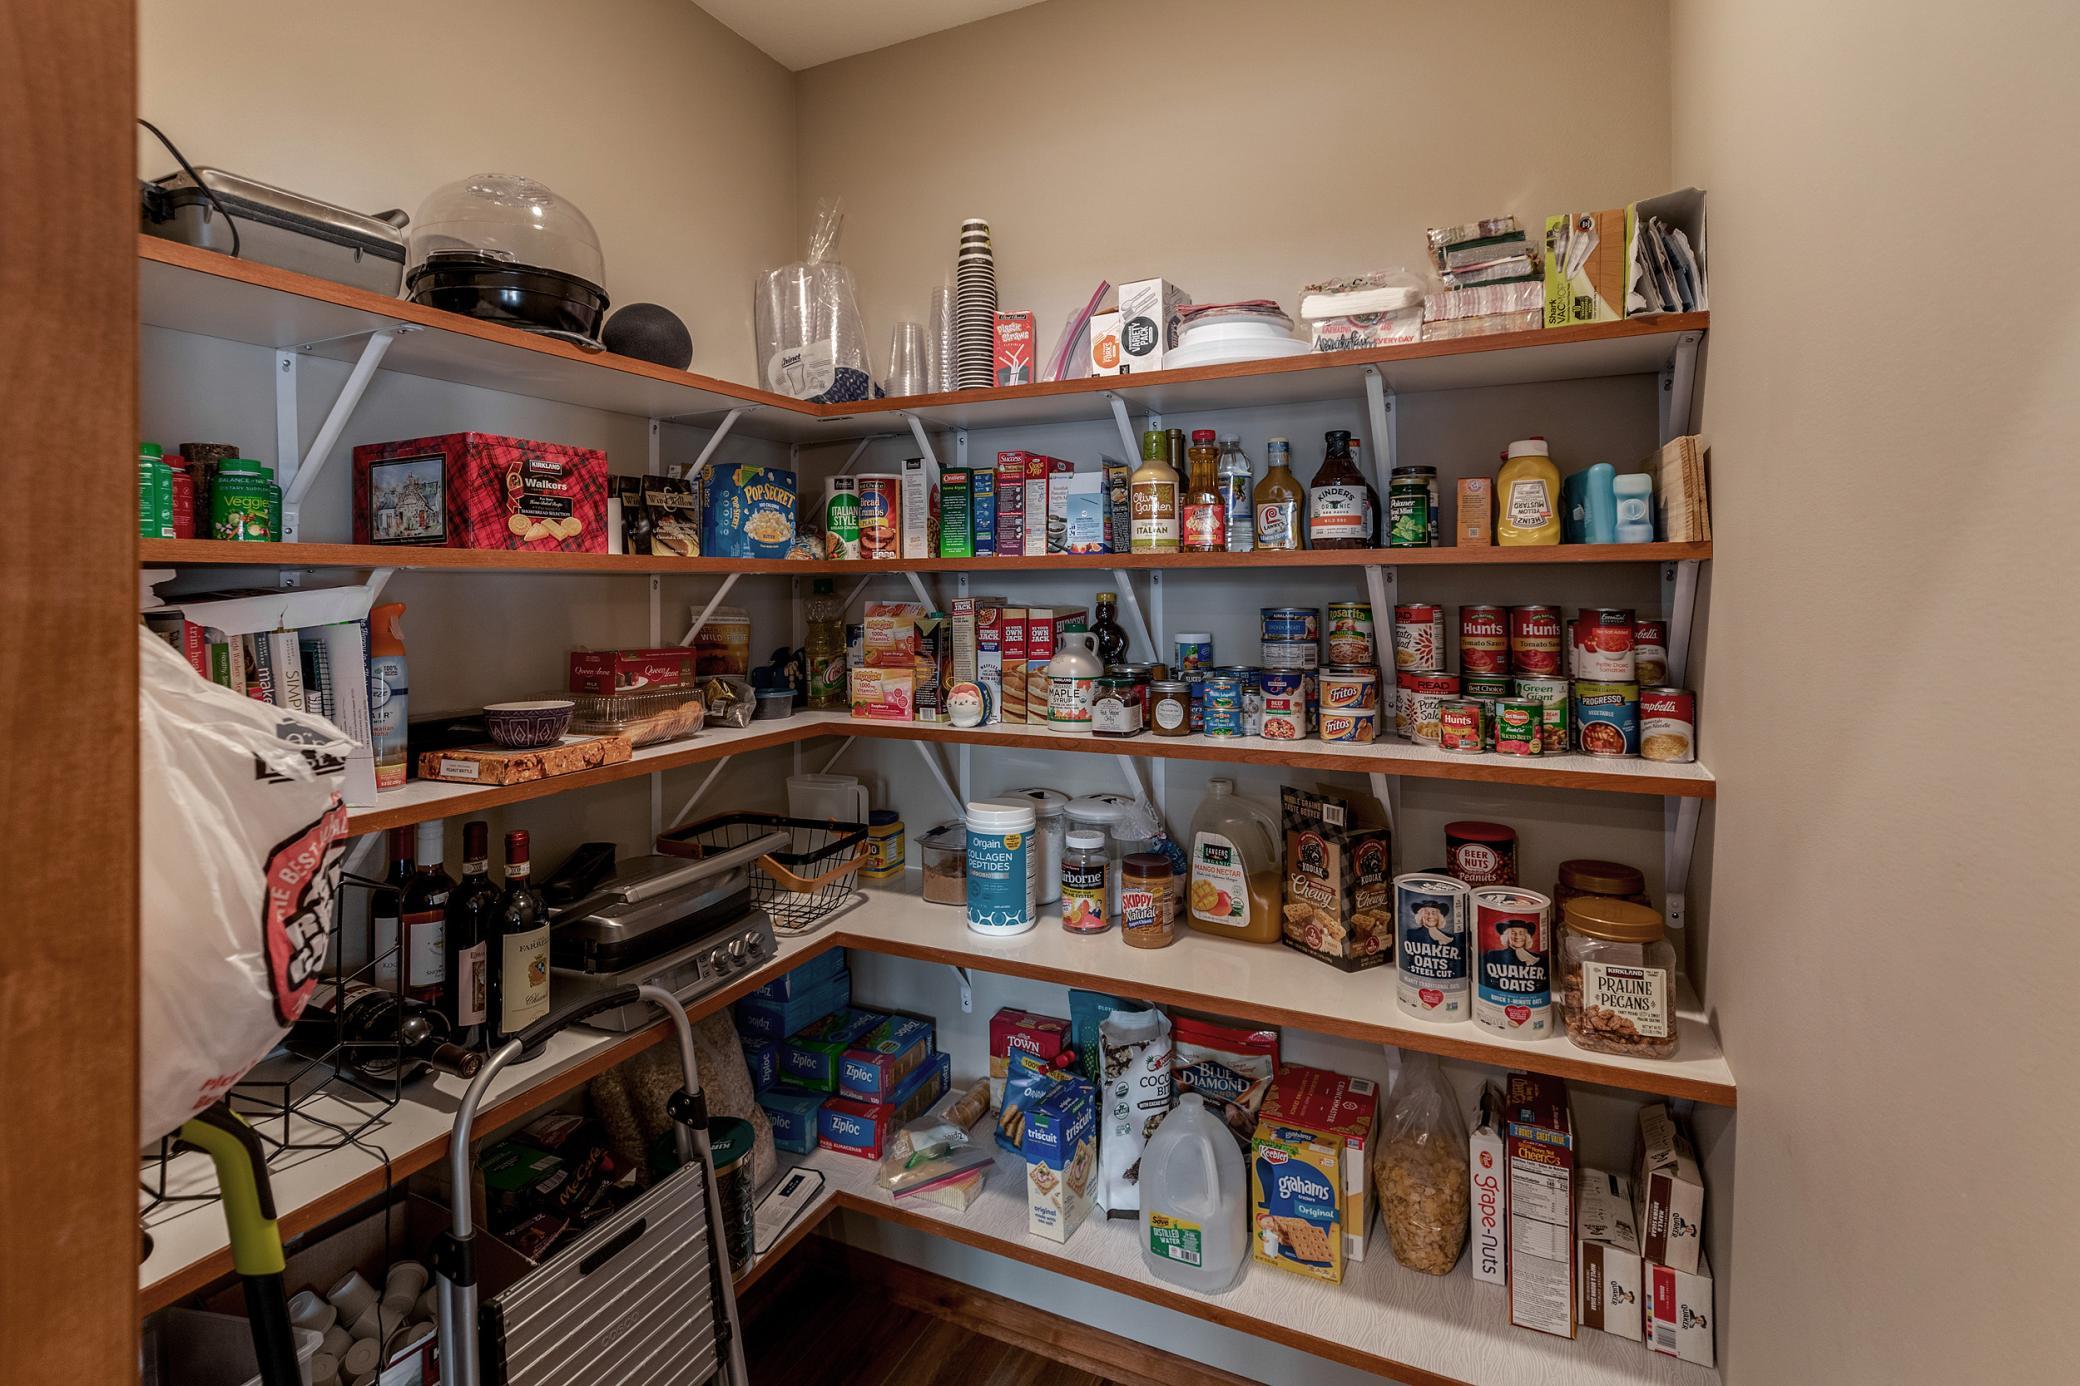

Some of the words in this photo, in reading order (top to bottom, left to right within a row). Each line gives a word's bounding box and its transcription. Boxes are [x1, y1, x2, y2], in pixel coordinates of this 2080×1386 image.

[1132, 322, 1141, 352] VARIETY
[1140, 326, 1149, 346] PACK
[531, 461, 561, 470] KIRKLAND
[525, 477, 568, 491] Walkers
[1317, 488, 1355, 502] KINDER'S
[831, 506, 859, 516] ITALIAN
[1135, 501, 1173, 515] Garden
[1513, 501, 1544, 509] MUSTARD
[834, 516, 857, 526] STYLE
[1517, 516, 1542, 524] HEINZ
[190, 626, 198, 648] trim
[1005, 628, 1023, 636] OWN
[644, 664, 666, 681] Queen
[258, 667, 273, 705] make
[1049, 688, 1080, 698] MAPLE
[1330, 686, 1358, 701] Fritos
[1522, 683, 1553, 693] Green
[1526, 692, 1553, 701] Giant
[1582, 694, 1622, 705] PROGRESSO
[1326, 719, 1350, 734] Fritos
[972, 837, 1001, 850] Orgain
[967, 850, 1013, 862] COLLAGEN
[1463, 849, 1489, 860] BEER
[969, 860, 1010, 871] PEPTIDES
[1194, 863, 1216, 873] MANGO
[1216, 867, 1242, 878] NECTAR
[1302, 862, 1324, 878] KODIAK
[1464, 857, 1490, 869] NUTS
[1360, 872, 1382, 885] KODIAK
[1458, 871, 1498, 882] Peanuts
[1291, 872, 1337, 911] Chewy
[1122, 893, 1152, 909] SKIPPY
[1355, 890, 1389, 909] Chewy
[1125, 905, 1157, 922] Natural
[1403, 940, 1462, 960] QUAKER
[1414, 955, 1448, 970] OATS
[1410, 966, 1435, 977] STEEL
[1436, 970, 1453, 978] CUT
[1486, 962, 1547, 980] QUAKER
[1607, 967, 1643, 977] KIRKLAND
[1500, 978, 1536, 992] OATS
[1598, 976, 1653, 996] PRALINE
[1601, 993, 1650, 1011] PECANS
[894, 1019, 920, 1038] Ziploc
[1007, 1035, 1040, 1053] TOWN
[762, 1052, 771, 1083] Ziploc
[792, 1052, 817, 1070] Ziploc
[845, 1063, 873, 1083] Ziploc
[1200, 1062, 1233, 1079] BLUE
[1182, 1070, 1250, 1093] DIAMOND
[832, 1117, 860, 1136] Ziploc
[1065, 1107, 1092, 1142] triscuit
[1027, 1128, 1058, 1144] triscuit
[1259, 1145, 1289, 1164] Keebler
[1278, 1175, 1330, 1201] grahams
[1034, 1205, 1057, 1217] original
[1299, 1205, 1335, 1218] Original
[1153, 1227, 1180, 1238] DISTILLED
[1160, 1237, 1180, 1245] WATER
